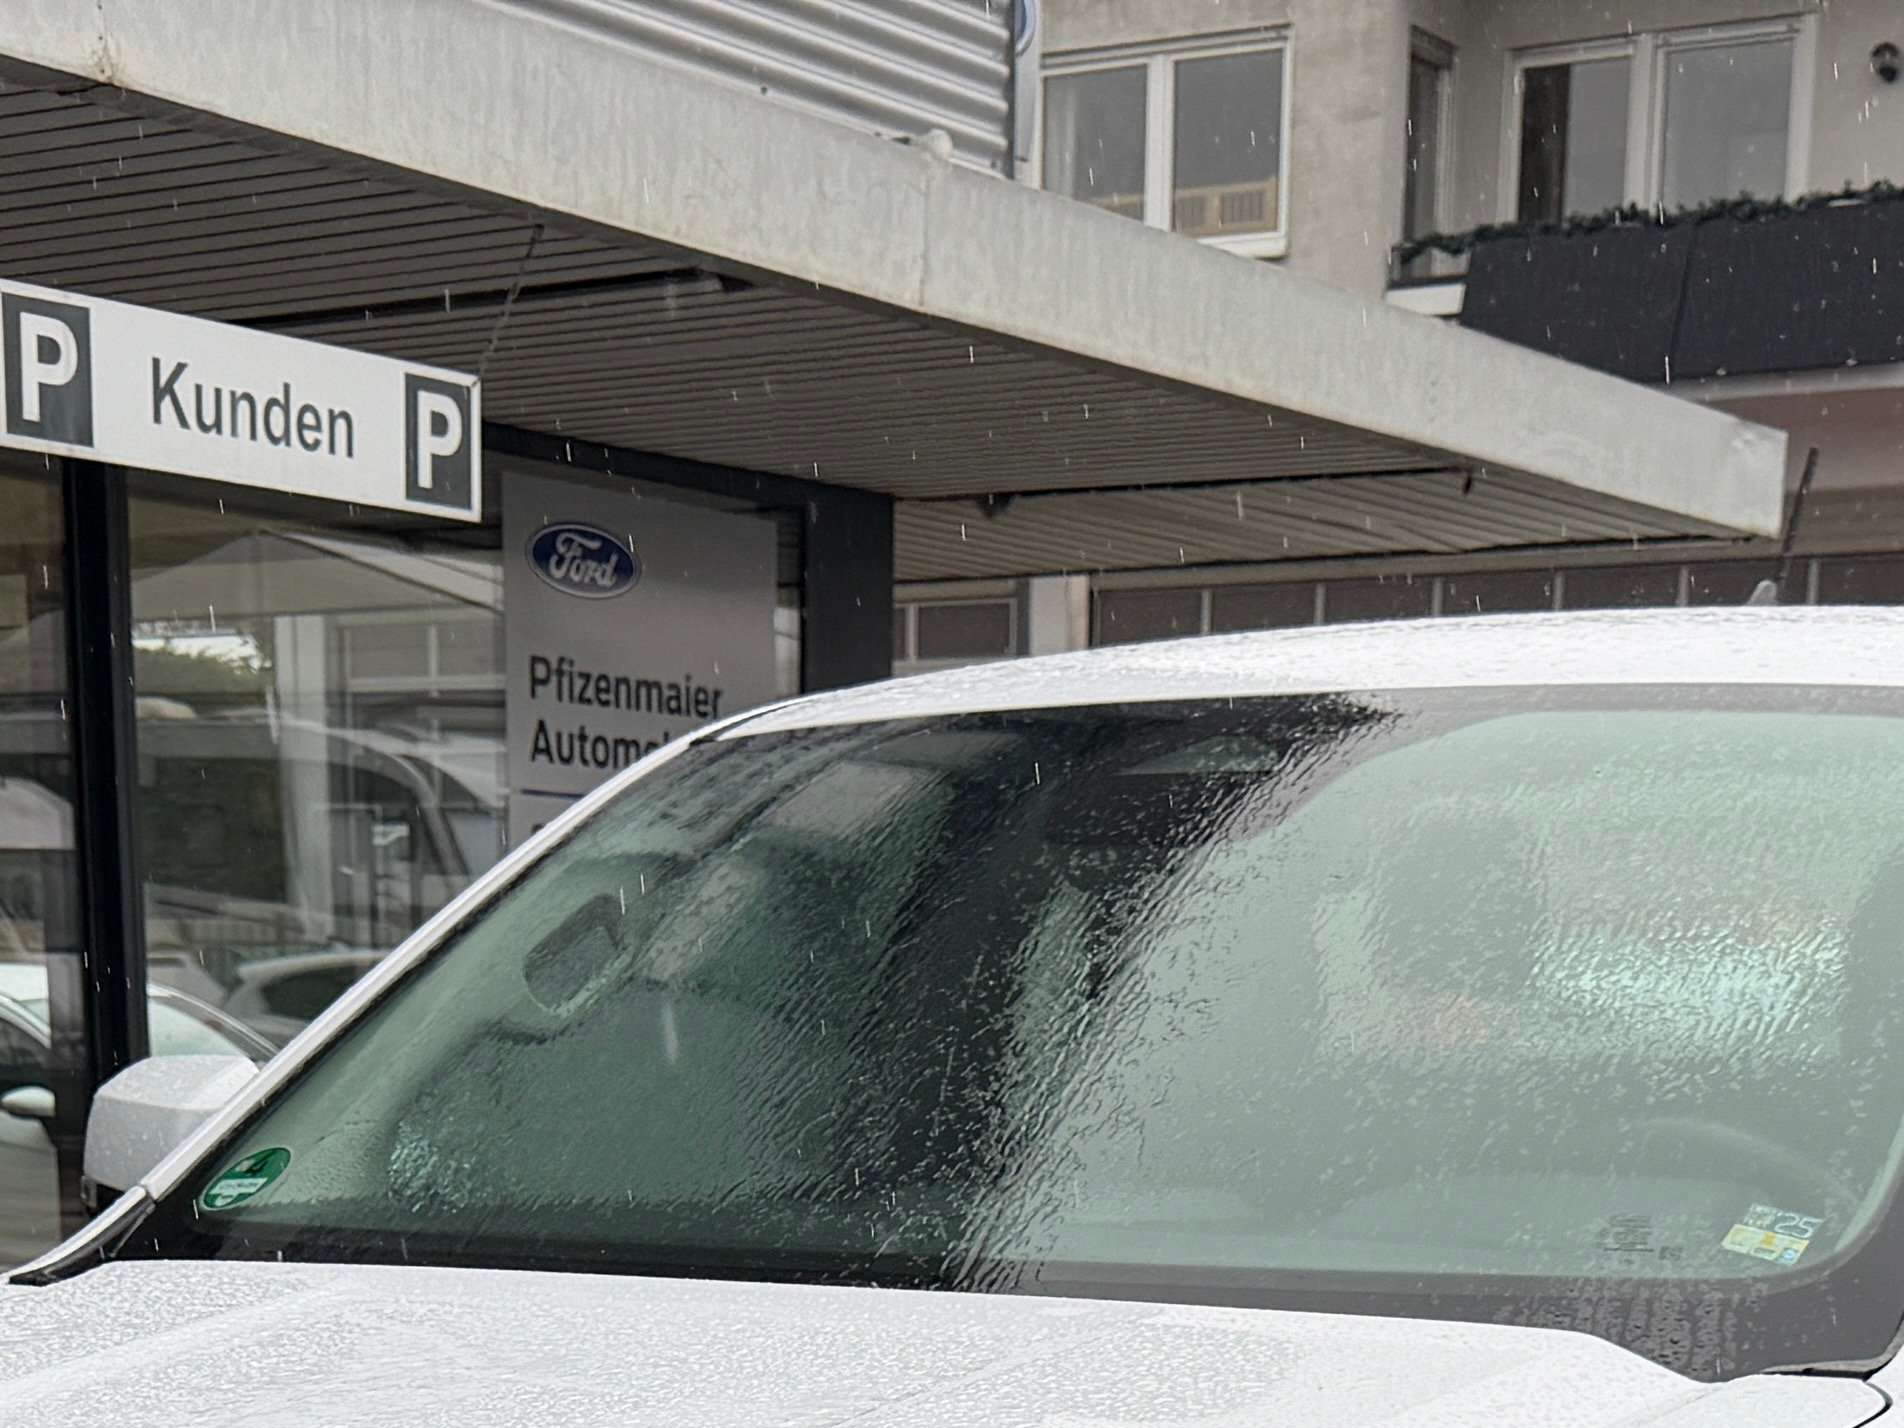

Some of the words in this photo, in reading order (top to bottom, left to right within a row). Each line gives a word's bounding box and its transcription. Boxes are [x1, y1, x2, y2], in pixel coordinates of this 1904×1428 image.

[19, 311, 79, 423] P
[151, 356, 355, 459] Kunden
[417, 390, 463, 489] P
[548, 531, 619, 588] Ford
[529, 654, 725, 720] Pfizenmaier
[530, 719, 670, 769] Autom
